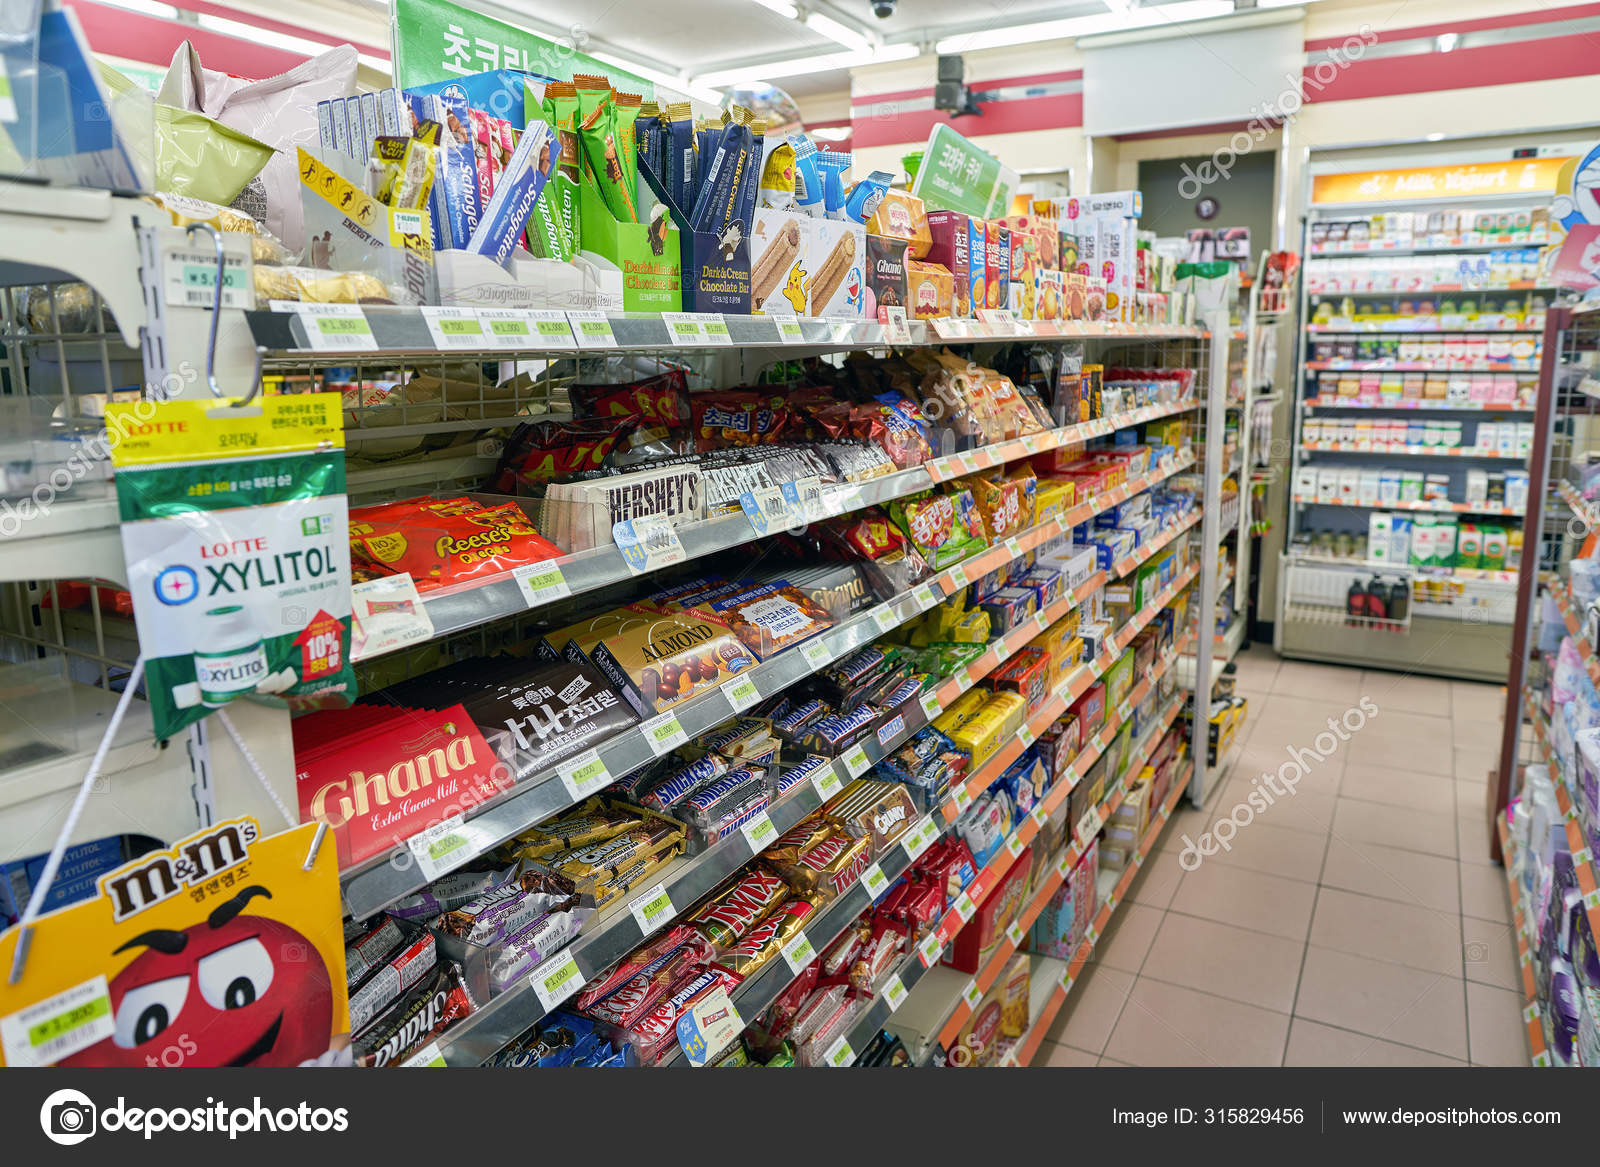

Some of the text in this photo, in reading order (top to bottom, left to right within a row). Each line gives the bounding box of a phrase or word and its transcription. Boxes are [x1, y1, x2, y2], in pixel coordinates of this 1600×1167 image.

[702, 265, 749, 281] Dark&Cream
[876, 259, 902, 275] Ghana
[700, 280, 750, 293] Chocolate Bar
[128, 421, 189, 437] LOTTE
[703, 407, 751, 432] 초코칩
[607, 471, 699, 523] HERSHEY'S
[910, 496, 954, 544] 홈런볼
[200, 536, 269, 559] LOTTE
[435, 526, 512, 559] Reese's
[624, 544, 644, 563] 1+1
[205, 545, 337, 597] XYLITOL
[811, 577, 865, 609] Ghana
[306, 630, 340, 660] 10%
[641, 624, 714, 663] ALMOND
[210, 660, 265, 683] XYLITOL
[822, 704, 875, 743] SNICKERS
[310, 735, 477, 830] Ghana
[656, 753, 717, 805] SNICKERS
[690, 768, 751, 809] SNICKERS
[370, 810, 402, 832] Extra
[433, 781, 459, 803] Milk
[873, 805, 906, 836] CRUNKY
[579, 835, 632, 864] CRUNKY
[796, 836, 848, 872] TWIX
[63, 860, 101, 878] XYLITOL
[831, 846, 871, 895] TWIX
[460, 883, 523, 916] CRUNKY
[642, 899, 663, 914] ₩1,000
[699, 870, 781, 937] TWIX
[545, 968, 569, 988] ₩1,000
[675, 972, 718, 1007] CHUNKY
[686, 1034, 705, 1057] 1+1
